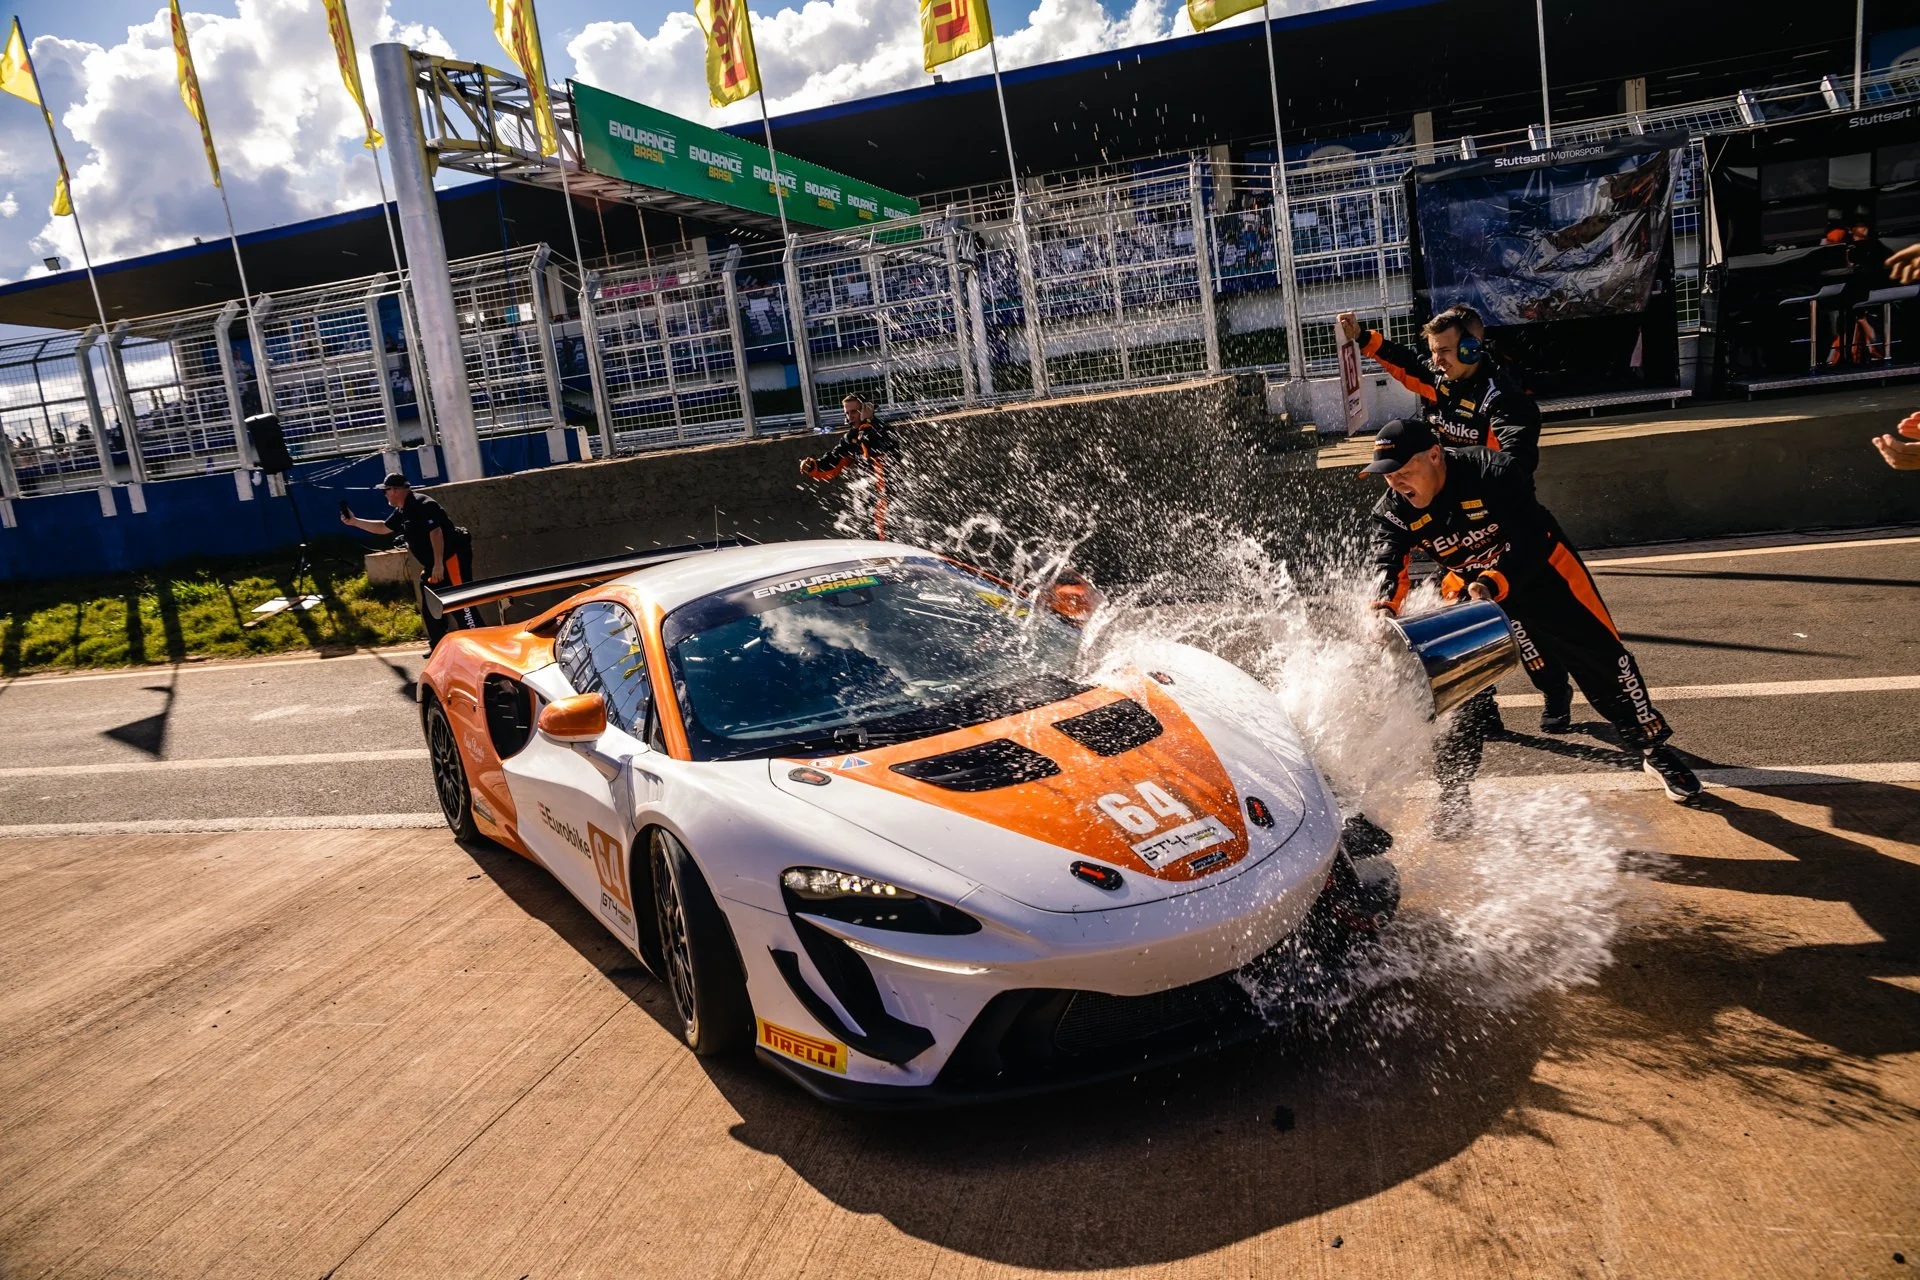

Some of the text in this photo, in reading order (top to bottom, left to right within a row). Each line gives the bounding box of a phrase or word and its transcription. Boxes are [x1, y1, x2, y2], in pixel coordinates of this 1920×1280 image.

[609, 119, 676, 154] ENDURANCE
[633, 144, 665, 164] BRASIL
[689, 145, 742, 174] ENDURANCE
[1494, 153, 1546, 168] Stuttgart
[708, 165, 733, 183] BRASIL
[804, 181, 841, 203] ENDURANCE
[847, 194, 878, 213] ENDURANCE
[753, 565, 894, 600] ENDURANCE
[806, 575, 876, 595] BRASIL
[1617, 654, 1657, 724] Eurobike
[1097, 780, 1194, 835] 64
[544, 806, 592, 860] Eurobike
[1140, 834, 1188, 861] GT4
[593, 831, 625, 900] 64
[602, 892, 619, 916] GT4
[762, 1021, 838, 1069] PIRELLI
